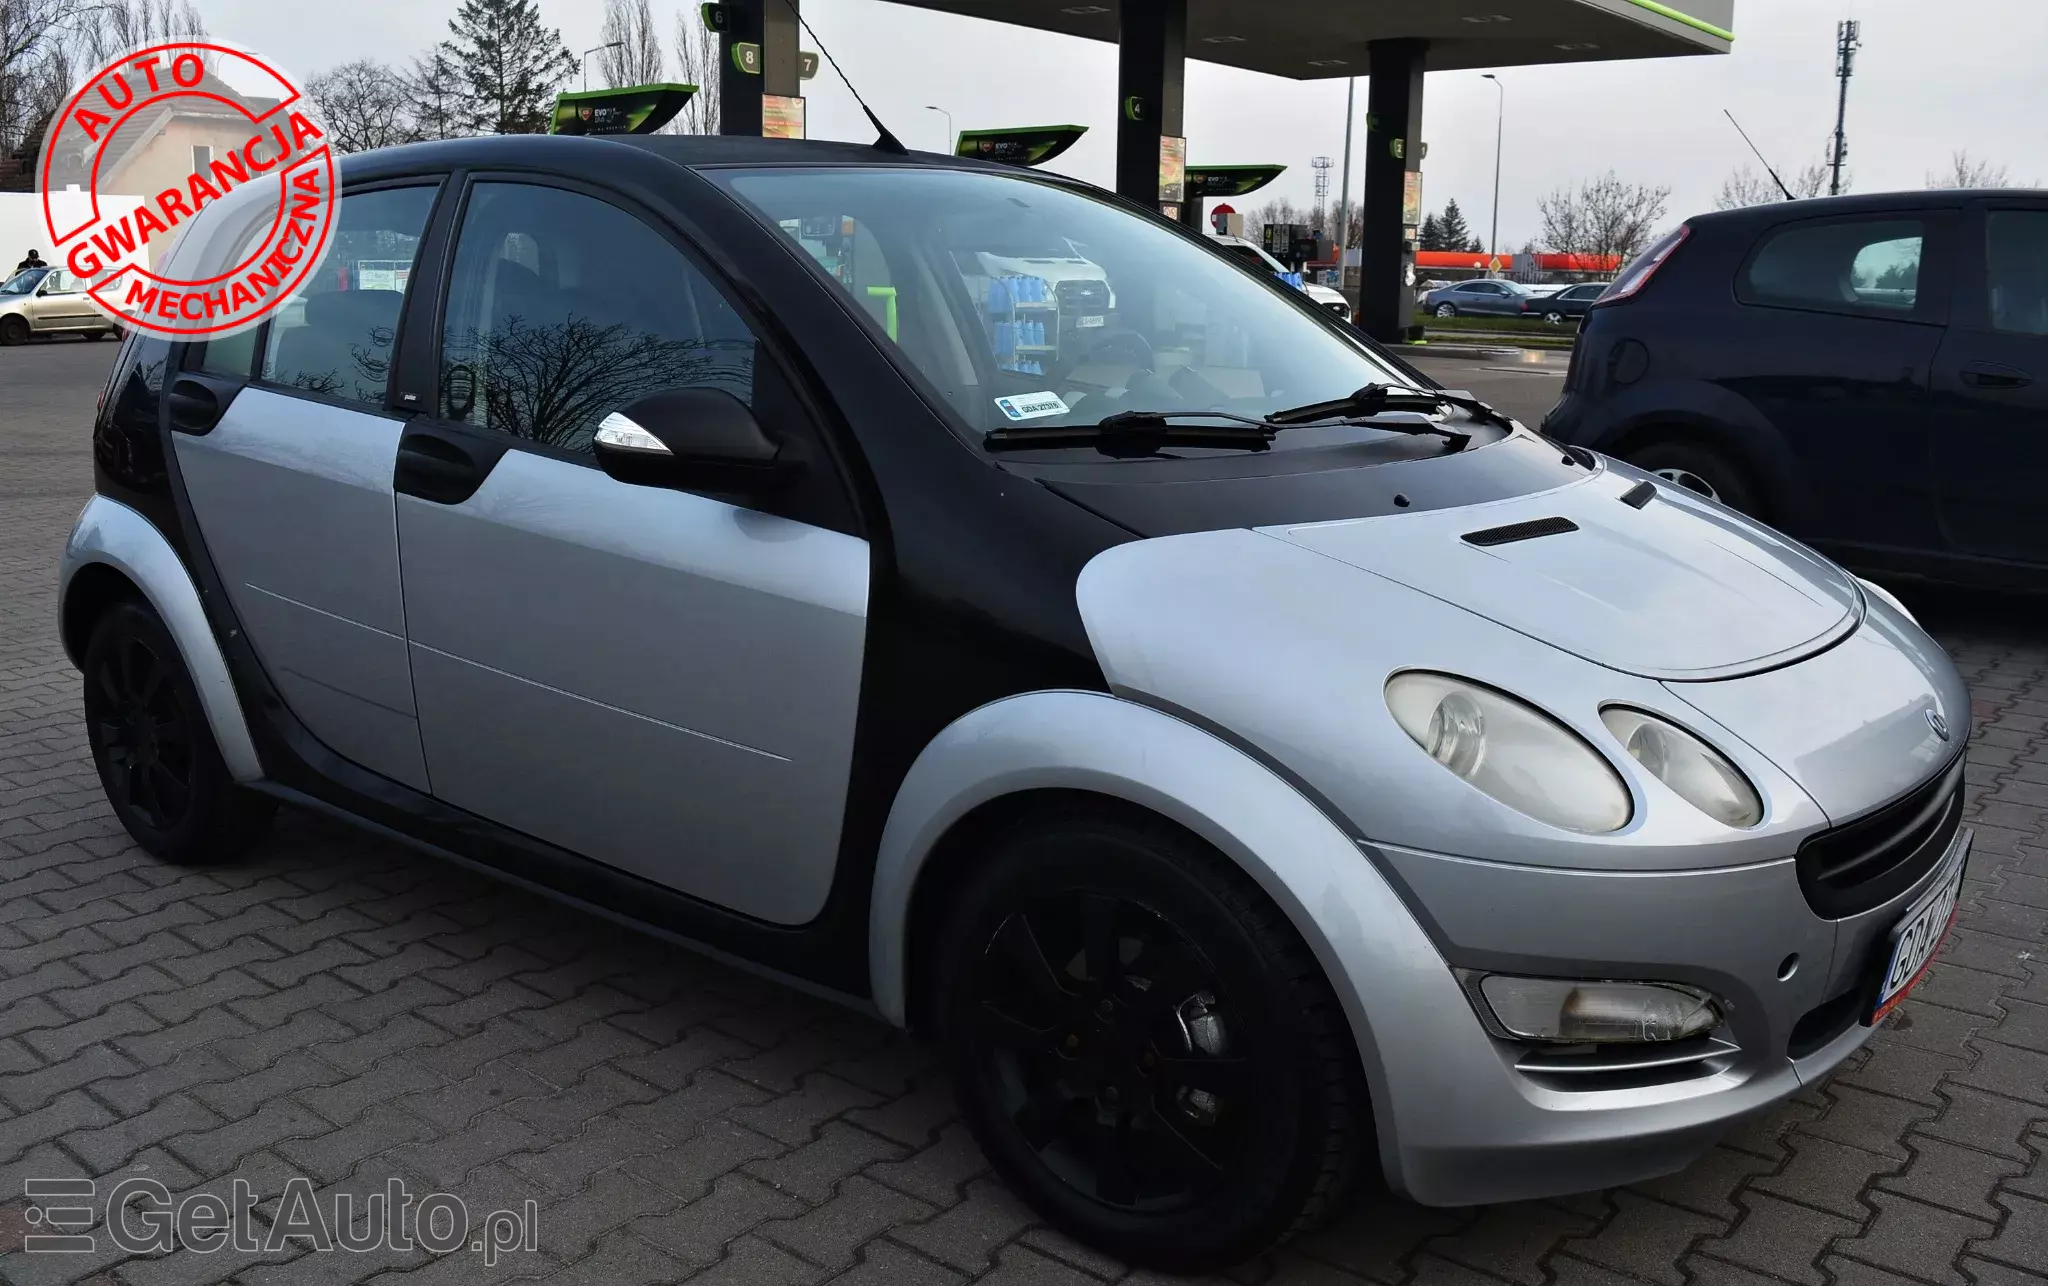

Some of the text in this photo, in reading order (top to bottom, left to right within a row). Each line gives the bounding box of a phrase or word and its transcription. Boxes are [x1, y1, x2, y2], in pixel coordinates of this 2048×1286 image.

[715, 11, 723, 23] 6
[745, 51, 754, 64] 8
[803, 58, 812, 71] 7
[594, 108, 607, 117] EVO
